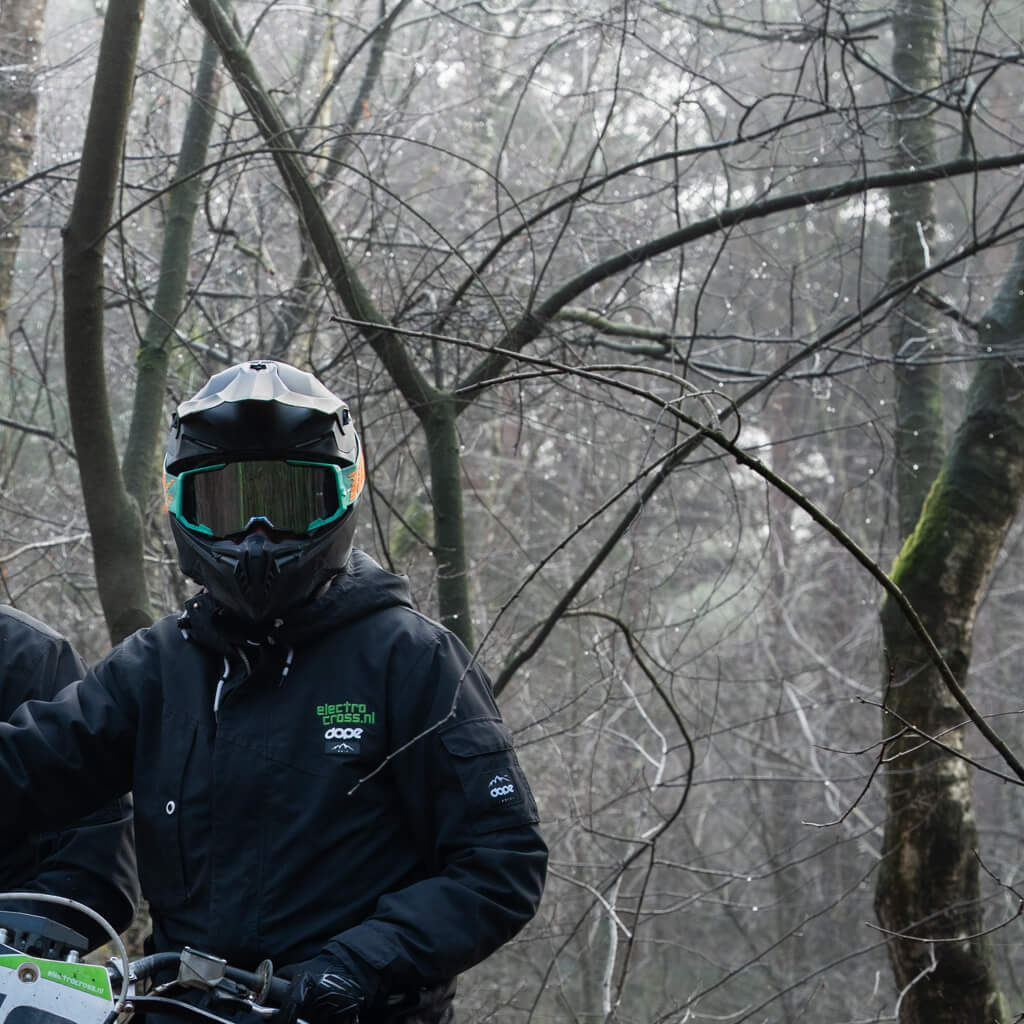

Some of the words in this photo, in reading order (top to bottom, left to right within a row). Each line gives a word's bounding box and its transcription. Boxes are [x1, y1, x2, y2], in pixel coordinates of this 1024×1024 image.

[316, 700, 367, 716] electro
[321, 711, 376, 726] cross.nl
[324, 727, 364, 740] dope
